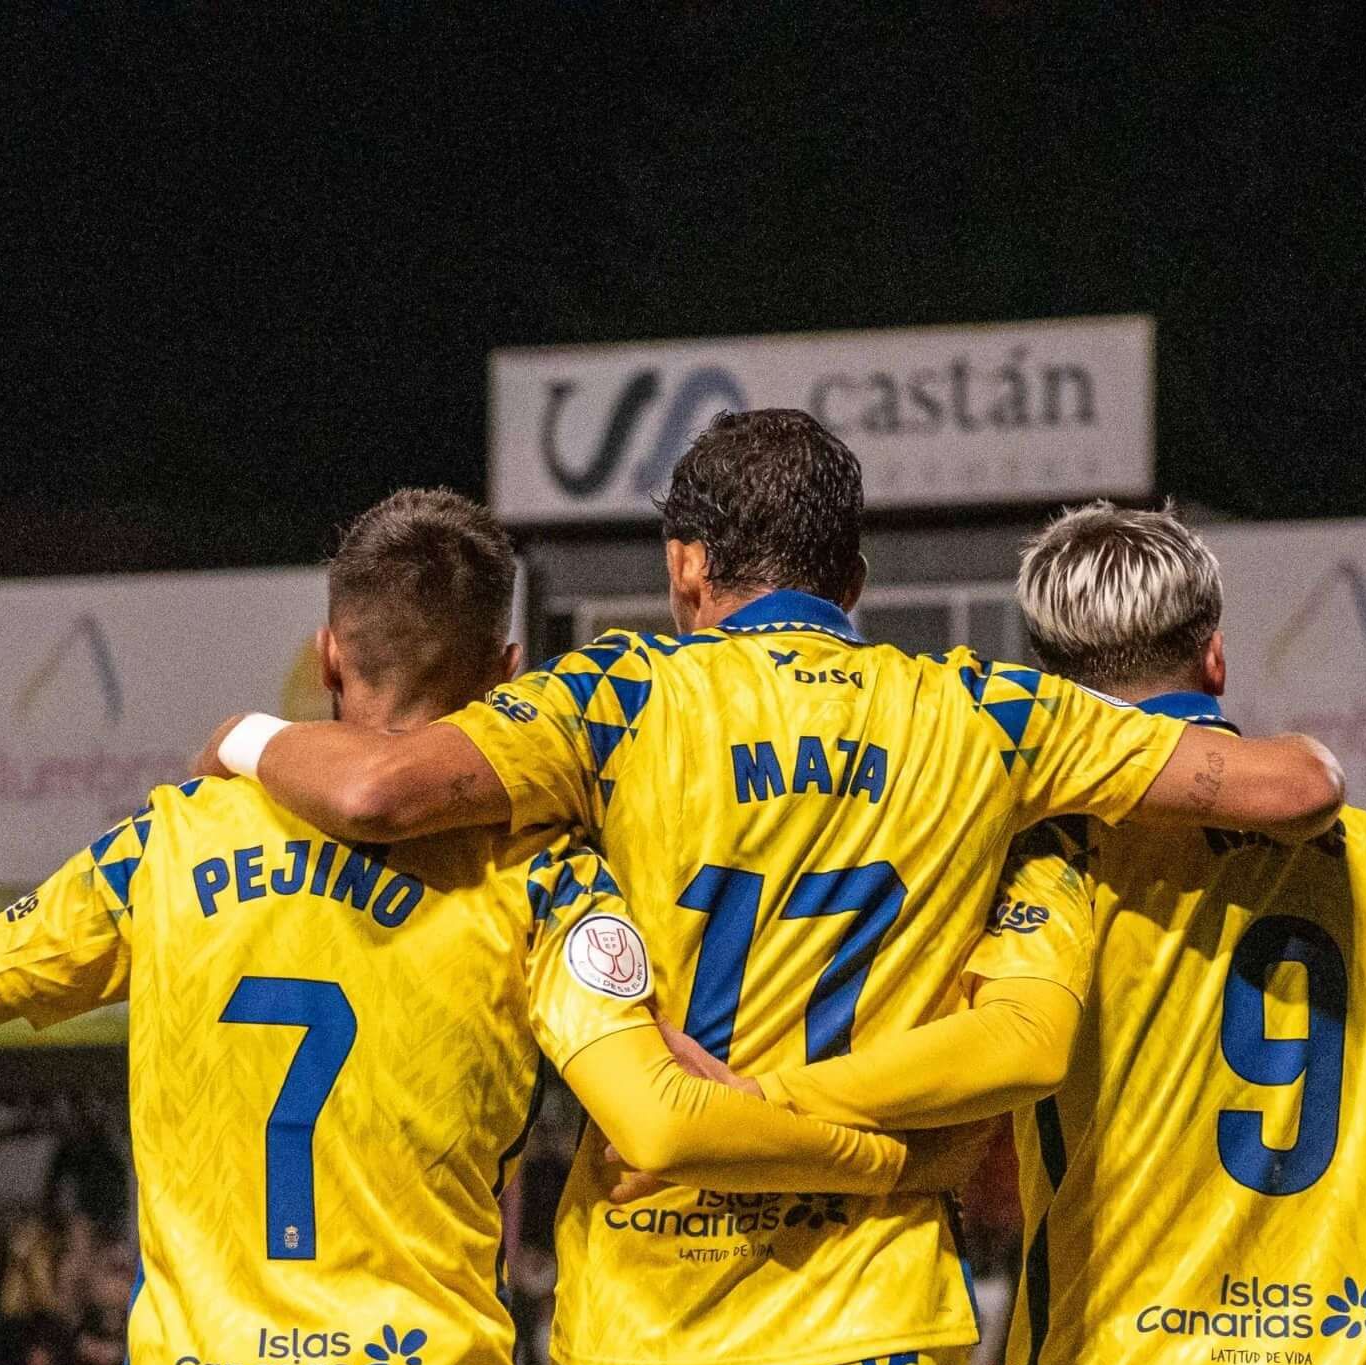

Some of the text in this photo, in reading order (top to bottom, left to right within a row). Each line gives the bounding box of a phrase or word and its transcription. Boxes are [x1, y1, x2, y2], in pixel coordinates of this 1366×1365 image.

[809, 344, 1097, 435] castán
[731, 736, 887, 804] MATA
[675, 860, 908, 1066] 17
[1217, 914, 1348, 1196] 9
[219, 976, 356, 1260] 7
[679, 1247, 730, 1261] LATITUD
[733, 1245, 748, 1259] DE
[1221, 1275, 1314, 1308] Islas
[259, 1328, 351, 1358] Islas
[1211, 1347, 1313, 1365] LATITUD DE VIDA
